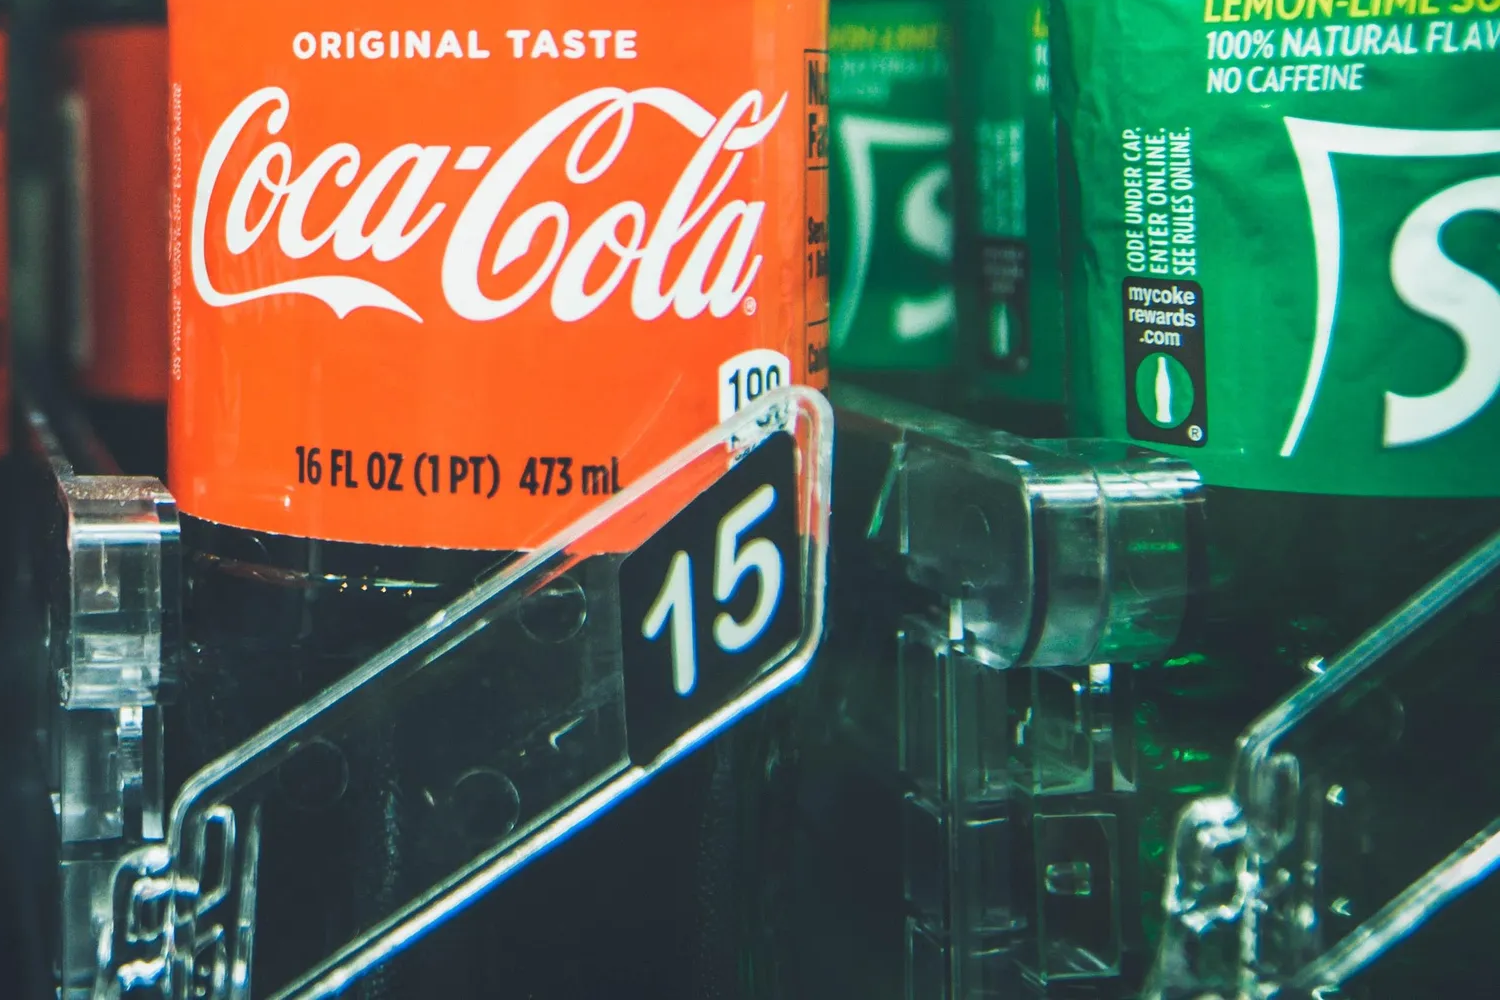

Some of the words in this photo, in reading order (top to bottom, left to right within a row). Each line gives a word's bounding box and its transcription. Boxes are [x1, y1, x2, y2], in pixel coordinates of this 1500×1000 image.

[292, 28, 490, 59] ORIGINAL
[508, 29, 638, 59] TASTE
[1206, 29, 1274, 60] 100%
[1281, 23, 1418, 58] NATURAL
[1206, 67, 1242, 94] NO
[1247, 63, 1365, 93] CAFFEINE
[1122, 127, 1142, 162] CAP.
[1145, 127, 1167, 206] ONLINE.
[1169, 127, 1193, 191] ONLINE.
[191, 86, 789, 324] Coca-Cola
[1123, 166, 1143, 225] UNDER
[1171, 194, 1195, 244] RULES
[1126, 229, 1146, 273] CODE
[1147, 212, 1169, 274] ENTER
[1172, 247, 1196, 276] SEE
[1128, 286, 1195, 306] mycoke
[1128, 307, 1196, 328] rewards
[1139, 329, 1181, 346] .com
[296, 446, 322, 485] 16
[330, 449, 358, 488] FL
[367, 451, 404, 491] OZ
[414, 452, 440, 496] (1
[450, 454, 501, 499] PT)
[519, 456, 573, 497] 473
[582, 456, 623, 497] mL
[641, 482, 785, 698] 15
